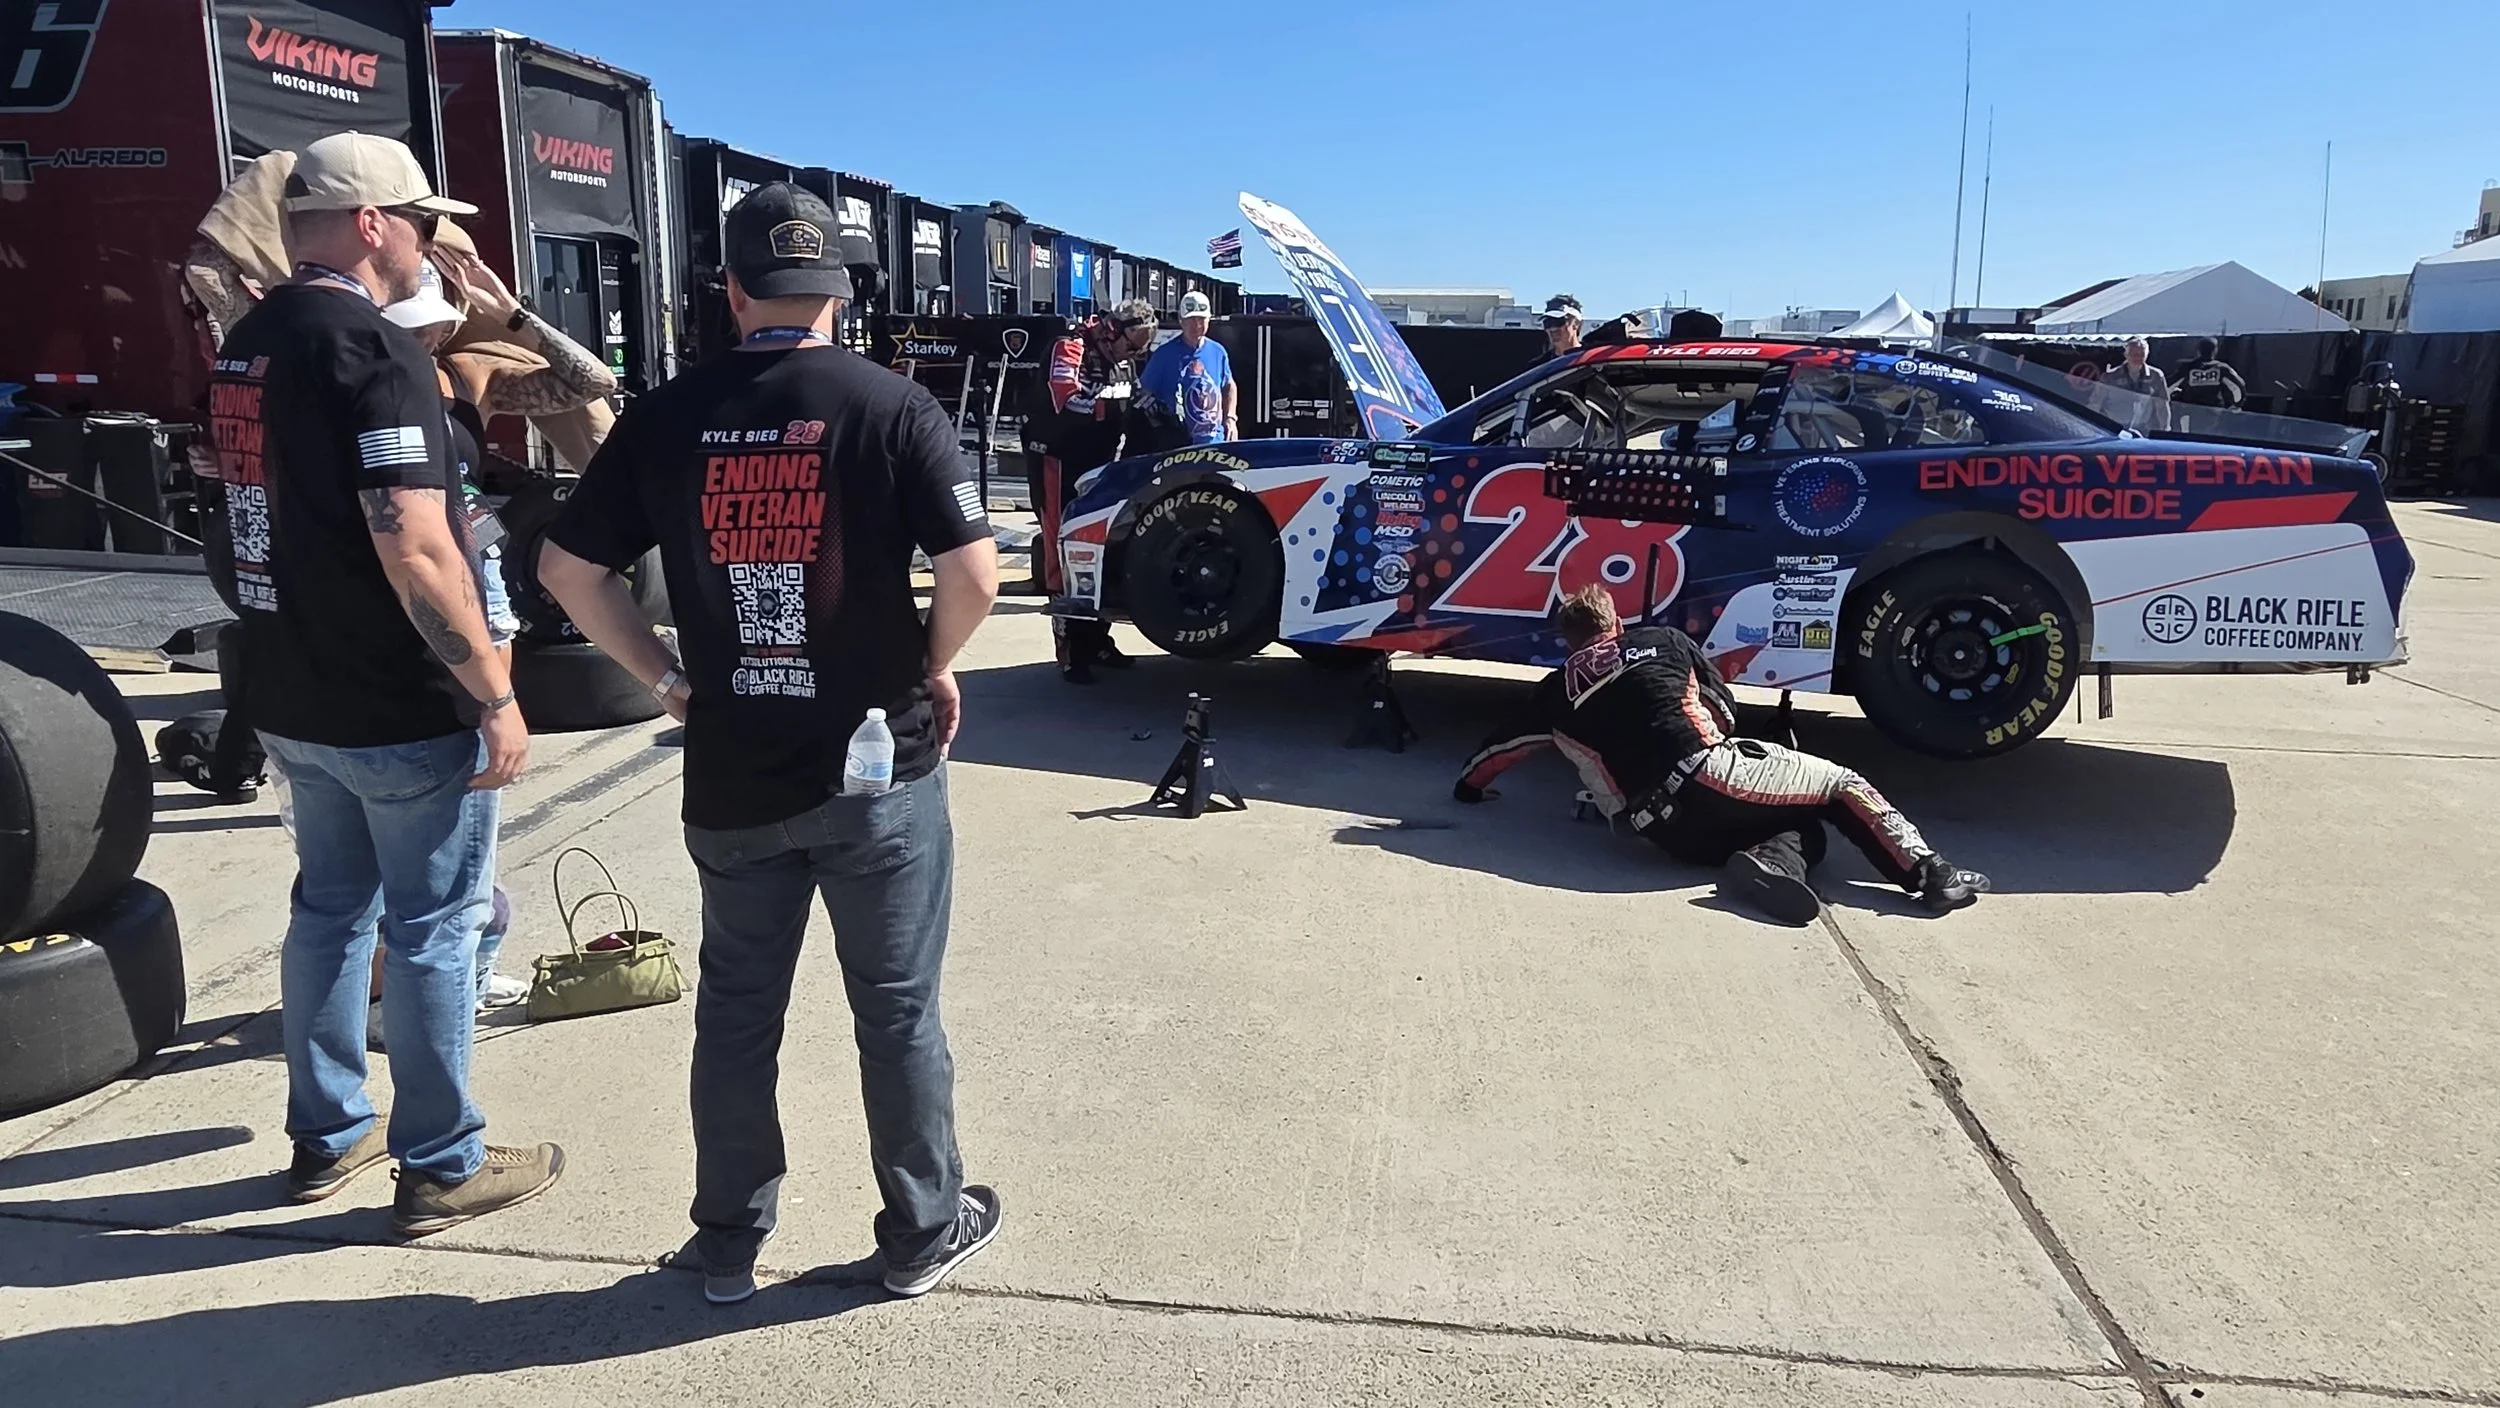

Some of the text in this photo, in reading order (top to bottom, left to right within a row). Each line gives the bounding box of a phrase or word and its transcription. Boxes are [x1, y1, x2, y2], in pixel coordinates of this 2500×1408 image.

[246, 14, 380, 88] VIKING
[272, 71, 360, 104] MOTORSPORTS
[52, 148, 168, 168] ALFREDO
[531, 129, 615, 174] VIKING
[550, 169, 608, 188] MOTORSPORTS
[904, 340, 958, 357] Starkey
[1647, 345, 1762, 356] KYLE SIEG
[1918, 362, 1950, 374] BLACK
[701, 419, 825, 445] KYLE SIEG 28
[705, 453, 822, 493] ENDING
[1152, 448, 1250, 474] GOODYEAR
[1775, 456, 1868, 488] VETERANS EXPLORING
[1919, 454, 2313, 490] ENDING VETERAN
[1369, 475, 1424, 487] COMETIC
[1375, 492, 1417, 502] LINCOLN
[1383, 502, 1420, 510] WELDERS
[2018, 488, 2182, 521] SUICIDE
[701, 491, 826, 530] VETERAN
[1134, 489, 1239, 538] GOODYEAR
[1774, 496, 1867, 537] TREATMENT SOLUTIONS
[1373, 526, 1414, 537] MSD
[1428, 462, 1686, 625] 28
[710, 528, 821, 565] SUICIDE
[1776, 556, 1810, 564] NIGHT
[1858, 589, 1896, 659] EAGLE
[2205, 595, 2365, 628] BLACK RIFLE
[1174, 620, 1229, 642] EAGLE
[2204, 627, 2271, 648] COFFEE
[1625, 647, 1658, 662] Racing
[749, 668, 816, 687] BLACK RIFLE
[749, 683, 816, 698] COFFEE COMPANY
[1985, 611, 2065, 746] GOODYEAR
